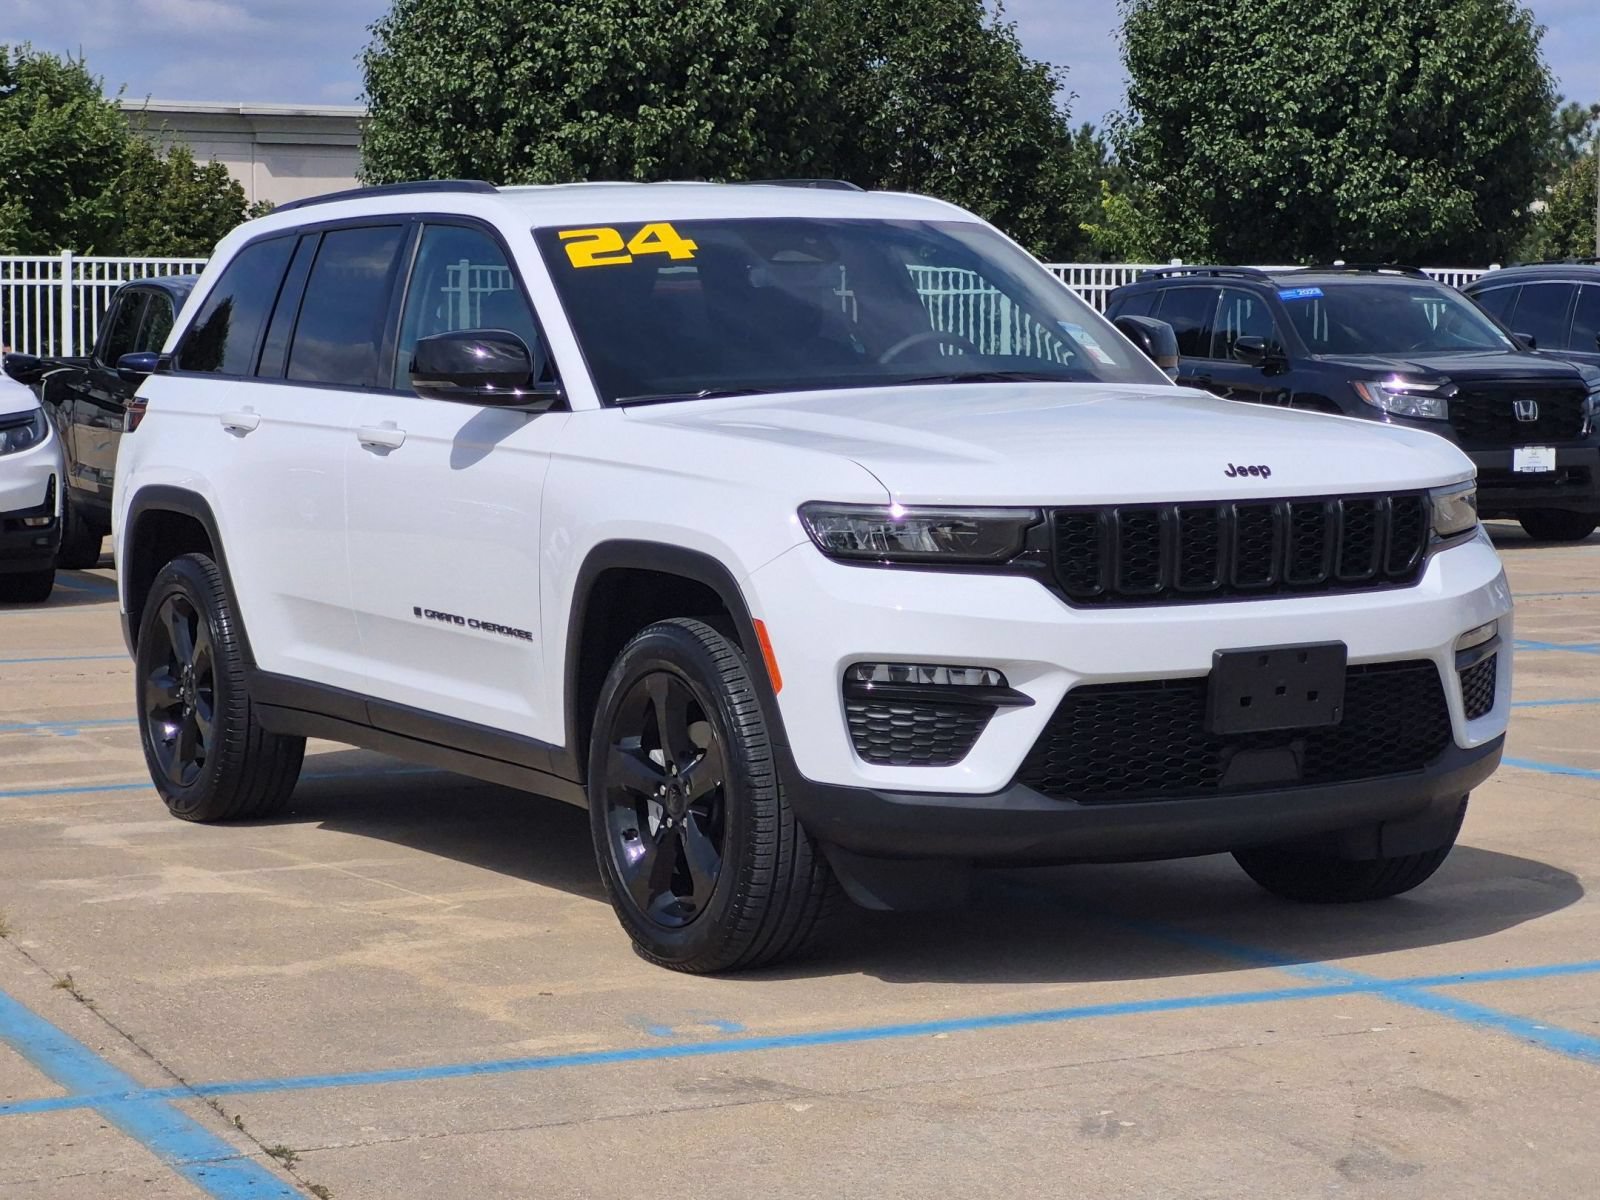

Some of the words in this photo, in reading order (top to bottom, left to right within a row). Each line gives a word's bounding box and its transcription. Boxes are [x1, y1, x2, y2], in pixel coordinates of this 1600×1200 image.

[558, 222, 699, 268] 24
[1224, 463, 1272, 479] Jeep
[424, 608, 465, 626] GRAND
[467, 618, 533, 641] CHEROKEE
